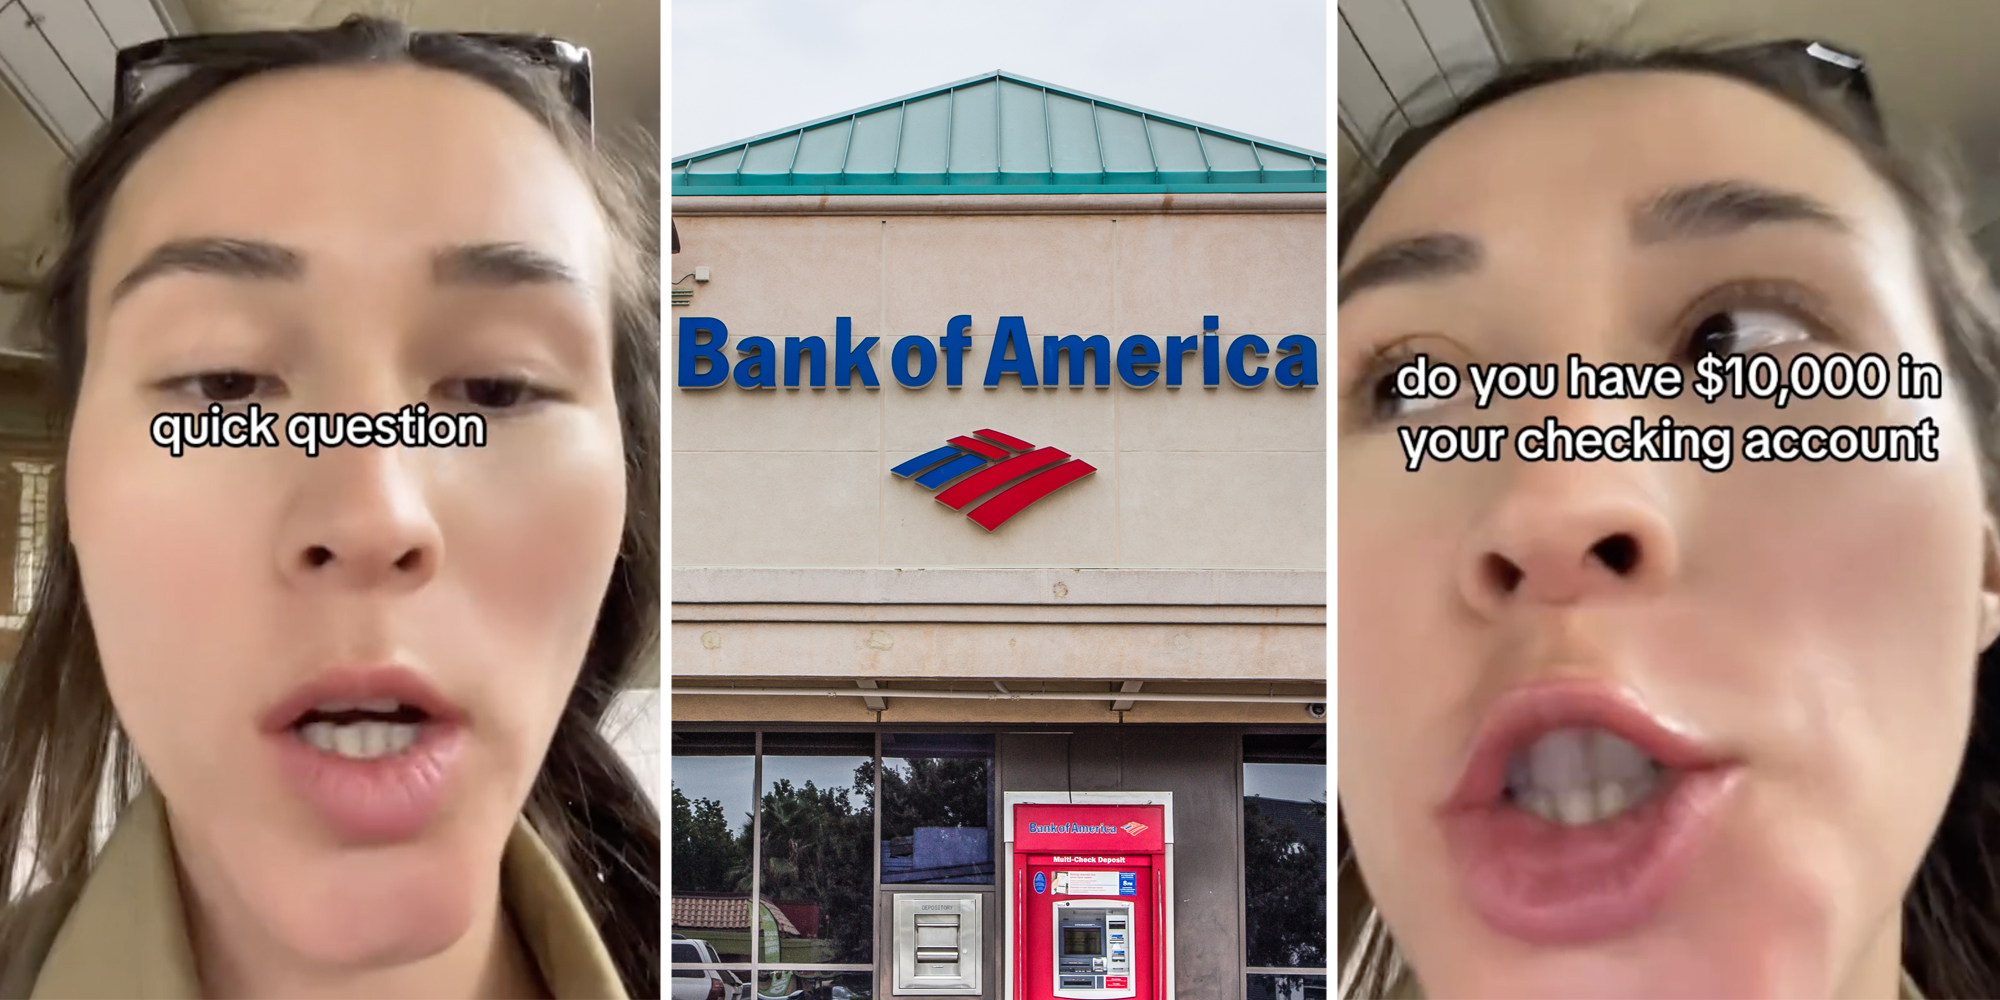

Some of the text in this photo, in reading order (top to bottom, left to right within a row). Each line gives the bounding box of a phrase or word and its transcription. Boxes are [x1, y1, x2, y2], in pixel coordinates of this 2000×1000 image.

[678, 315, 1319, 390] Bank of America
[1029, 822, 1117, 834] Bank of America
[1098, 856, 1126, 864] Deposit
